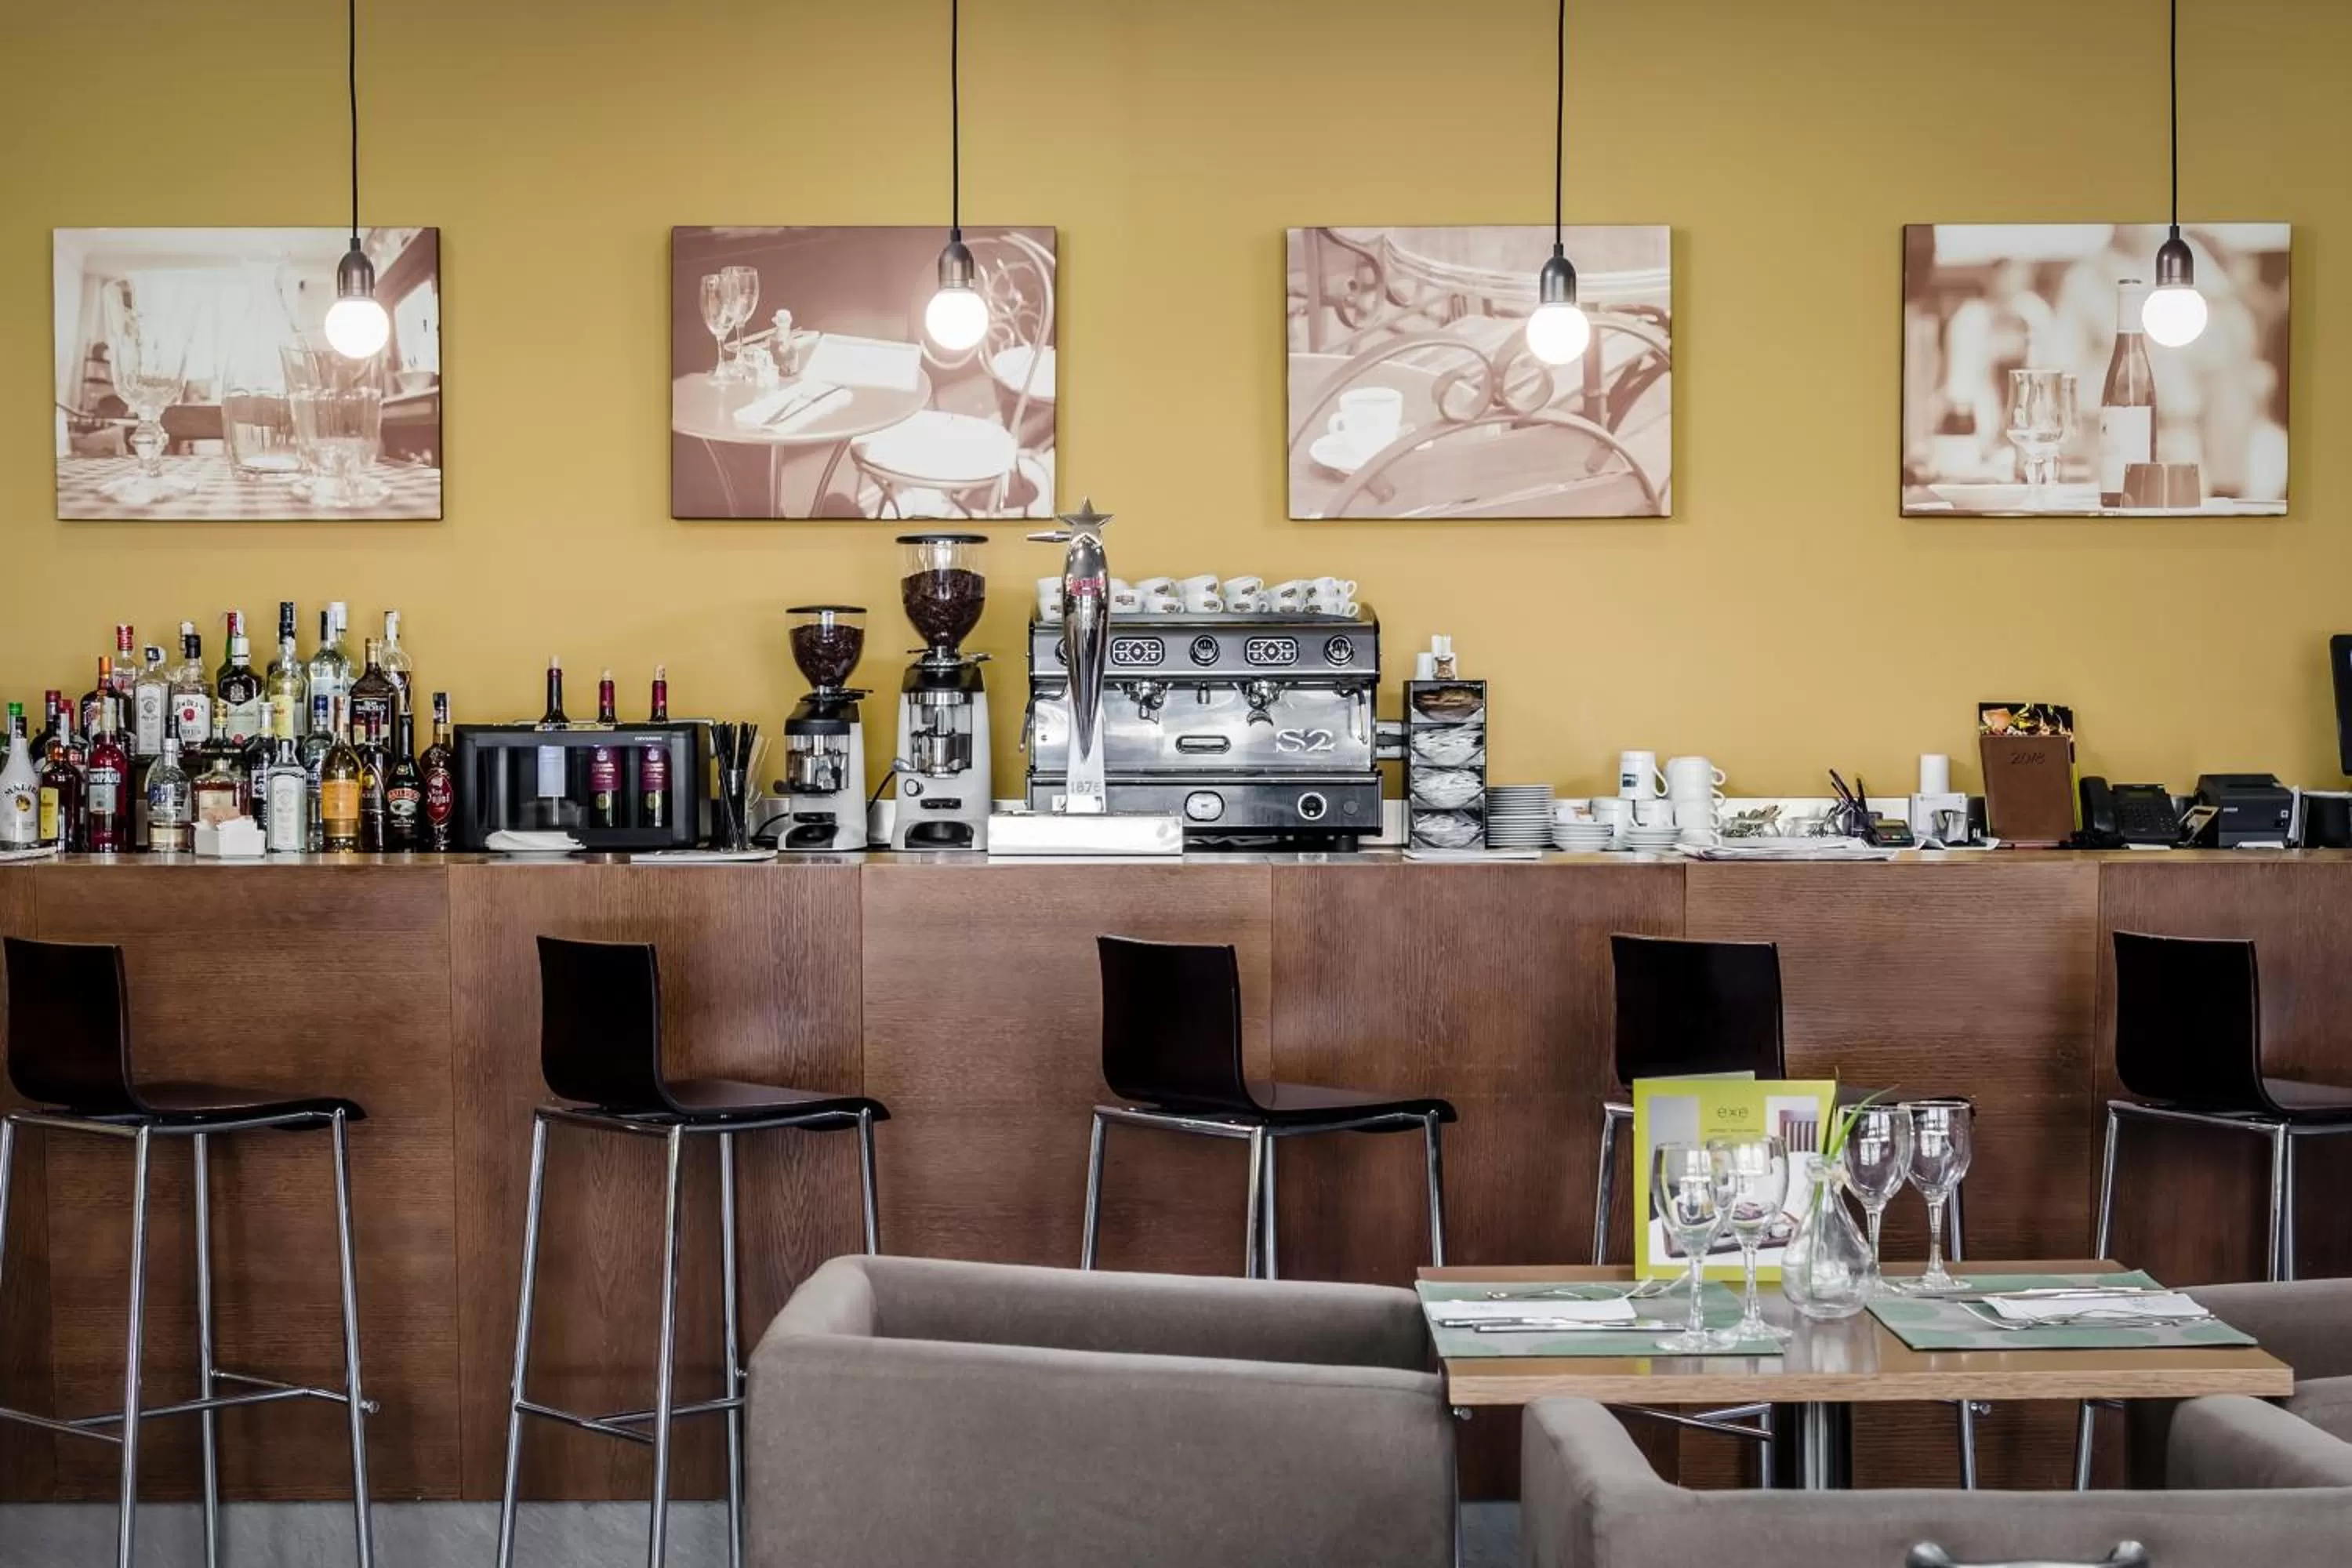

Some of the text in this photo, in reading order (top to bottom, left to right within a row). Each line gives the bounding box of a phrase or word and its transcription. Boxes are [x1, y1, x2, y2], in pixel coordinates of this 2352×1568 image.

[1276, 728, 1334, 752] S2
[2010, 752, 2045, 766] 2018
[5, 784, 38, 796] MALIB
[1717, 1107, 1749, 1118] exe
